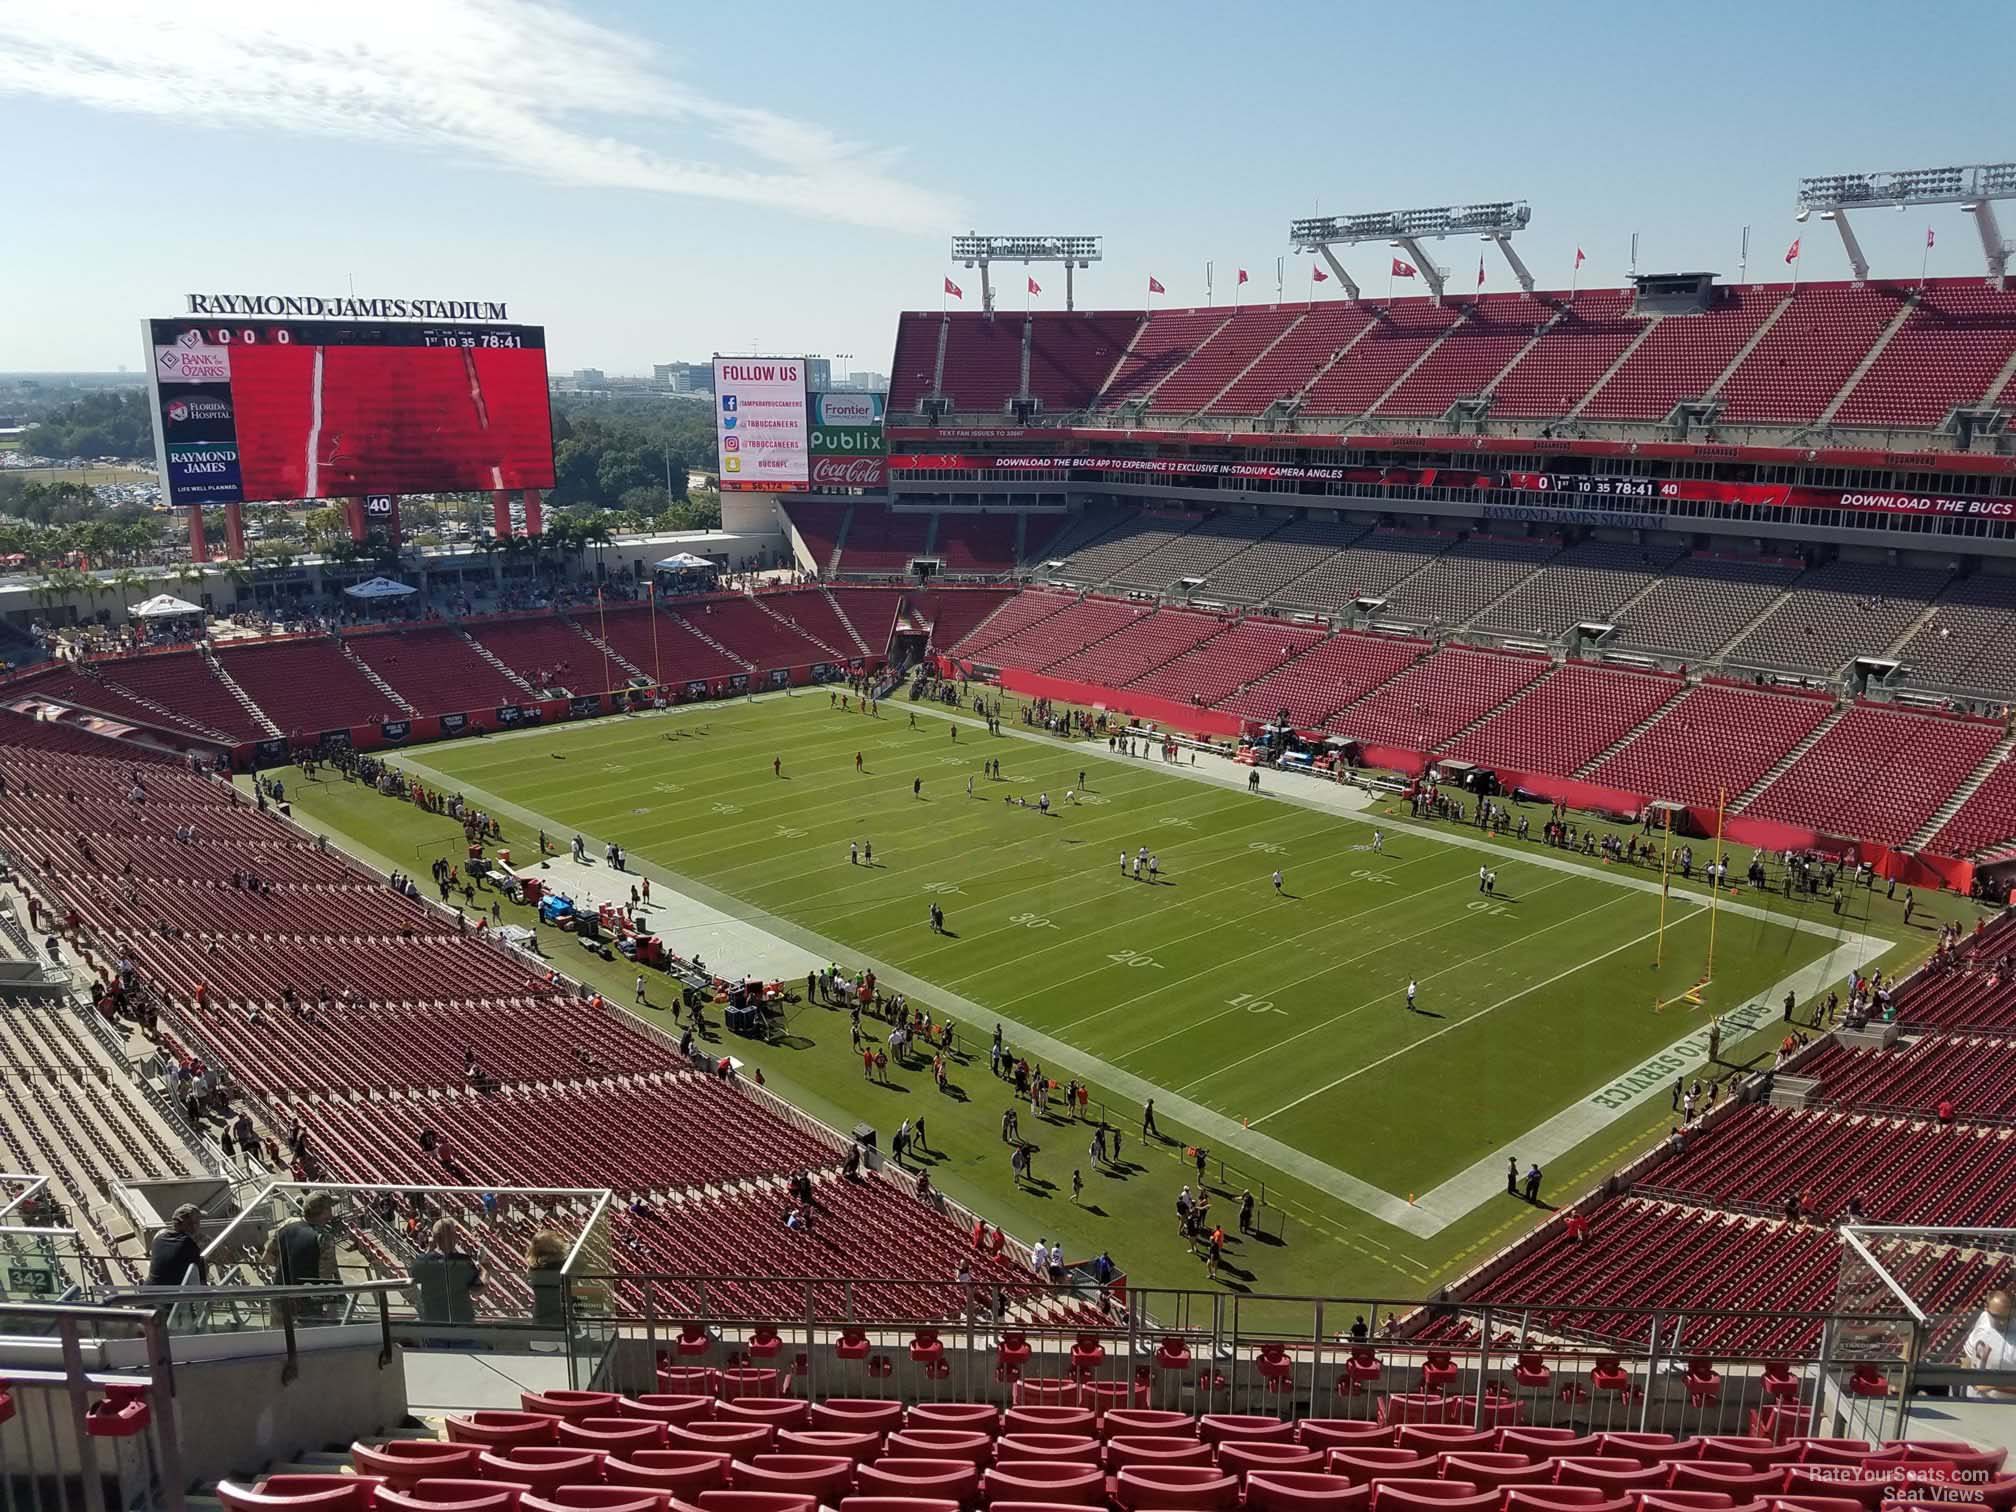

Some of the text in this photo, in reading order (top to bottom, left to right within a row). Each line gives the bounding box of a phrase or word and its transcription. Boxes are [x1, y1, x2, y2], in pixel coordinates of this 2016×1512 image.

[187, 294, 508, 321] RAYMOND JAMES STADIUM
[218, 329, 231, 344] 0
[243, 329, 256, 344] 0
[277, 329, 290, 344] 0
[443, 337, 457, 348] 10
[461, 337, 476, 348] 35
[481, 335, 522, 349] 78:41
[181, 365, 225, 377] OZARKS
[722, 365, 797, 381] FOLLOW US
[190, 402, 226, 411] FLORIDA
[825, 403, 871, 415] Frontier
[191, 411, 232, 420] HOSPITAL
[810, 432, 881, 449] Publix
[170, 450, 237, 463] RAYMOND
[183, 462, 226, 474] JAMES
[995, 458, 1343, 479] DOWNLOAD THE BUCS APP TO EXPERIENCE 12 EXCLUSIVE IN-STADIUM CAMERA ANGLES
[1538, 477, 1548, 489] 0
[1579, 482, 1591, 492] 10
[1596, 483, 1610, 493] 35
[1615, 482, 1653, 496] 78:41
[1661, 484, 1678, 495] 40
[369, 498, 390, 512] 40
[1840, 494, 2013, 516] DOWNLOAD THE BUCS
[1008, 912, 1050, 929] 30
[1106, 949, 1153, 968] 20
[1224, 993, 1274, 1014] 10
[1591, 1054, 1686, 1110] SERVICE
[12, 1271, 47, 1286] 342
